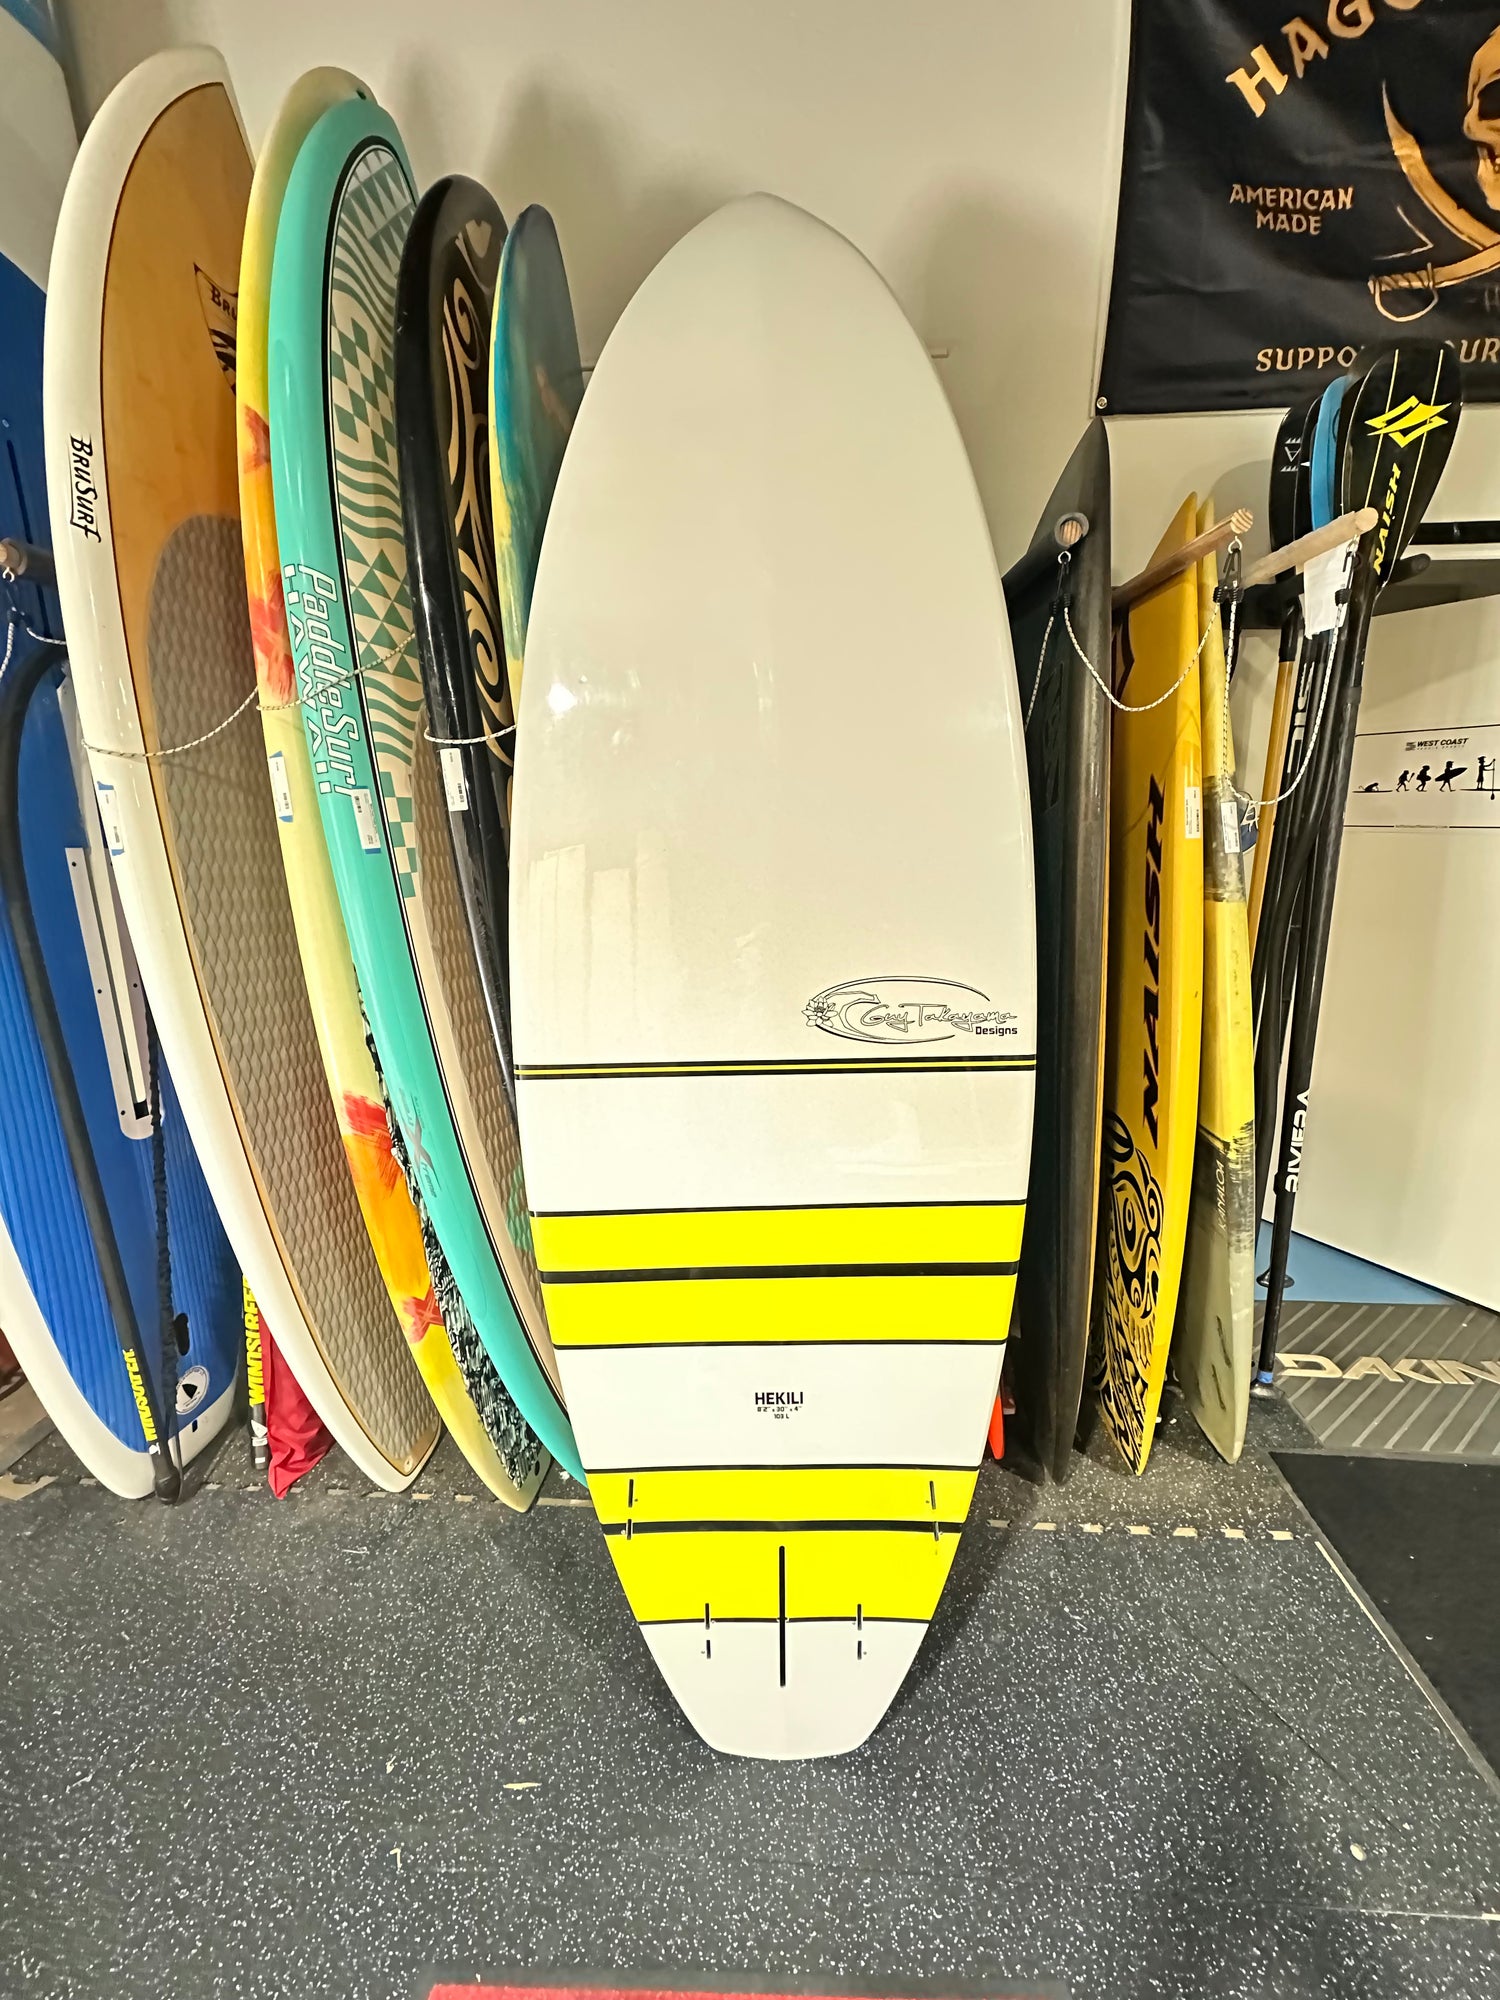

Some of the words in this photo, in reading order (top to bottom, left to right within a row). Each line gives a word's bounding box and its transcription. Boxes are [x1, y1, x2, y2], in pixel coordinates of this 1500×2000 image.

[1225, 0, 1425, 117] HAG
[1229, 184, 1354, 211] AMERICAN
[1256, 211, 1323, 235] MADE
[1373, 462, 1401, 576] NAISH
[1417, 739, 1440, 747] WEST
[1440, 737, 1469, 746] COAST
[1143, 774, 1167, 1149] NAISH
[975, 1025, 1018, 1037] Designs
[754, 1391, 804, 1405] HEKILI
